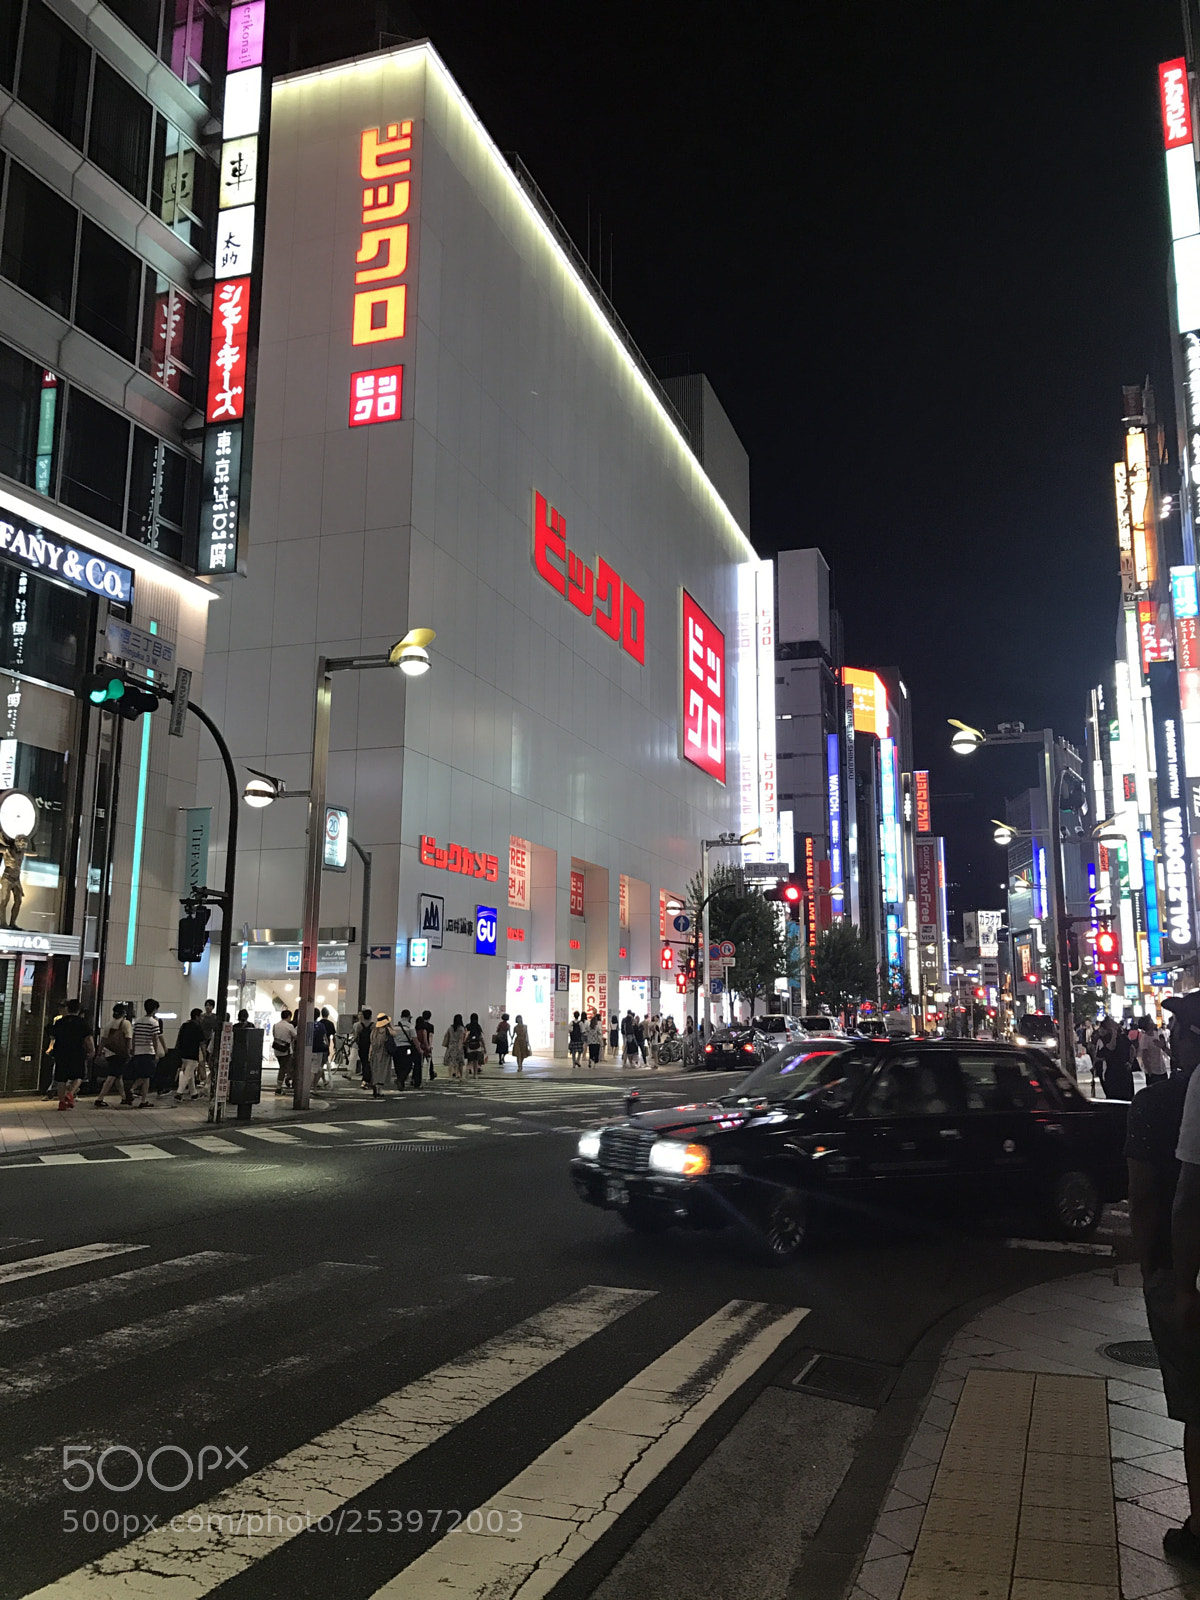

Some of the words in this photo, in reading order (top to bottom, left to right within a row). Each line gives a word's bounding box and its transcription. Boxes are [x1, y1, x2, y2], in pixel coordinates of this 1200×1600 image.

[352, 120, 413, 346] ビックロ
[533, 489, 645, 666] ビックロ
[329, 819, 338, 833] 20
[420, 835, 499, 882] ビックカメラ
[509, 847, 526, 869] REE
[1163, 806, 1191, 945] CALZEDONIA
[477, 918, 496, 943] GU
[587, 973, 595, 992] BIC
